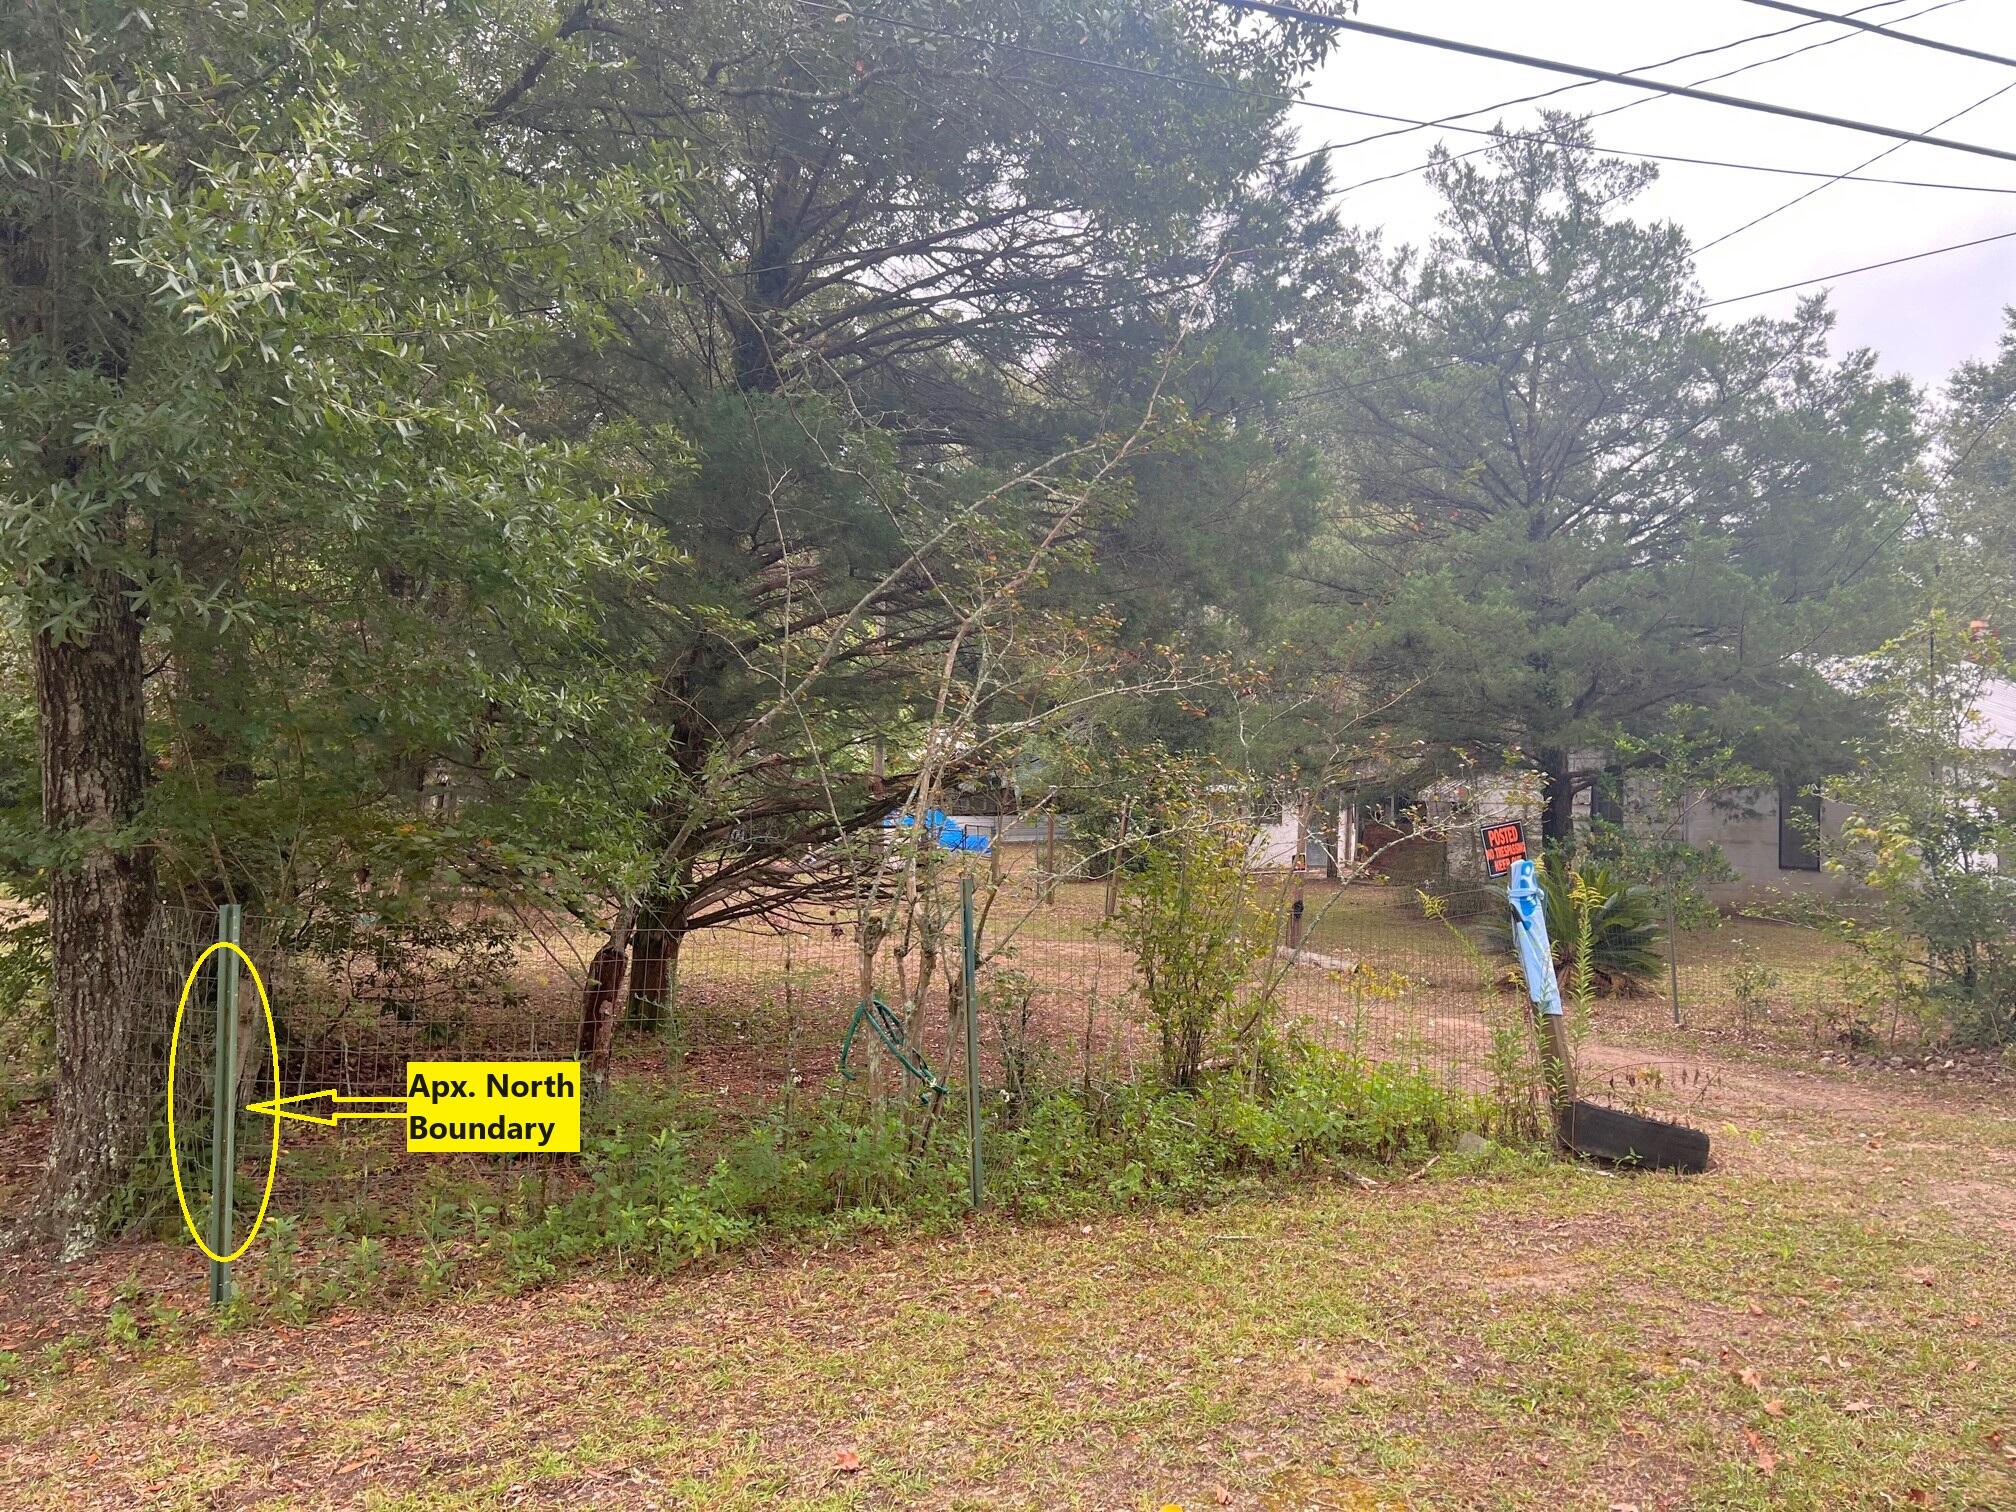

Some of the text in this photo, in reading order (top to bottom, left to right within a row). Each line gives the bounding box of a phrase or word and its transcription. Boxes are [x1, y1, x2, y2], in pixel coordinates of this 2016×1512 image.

[1487, 825, 1518, 847] POSTED
[1486, 848, 1495, 861] NO
[1494, 858, 1511, 872] KEEP
